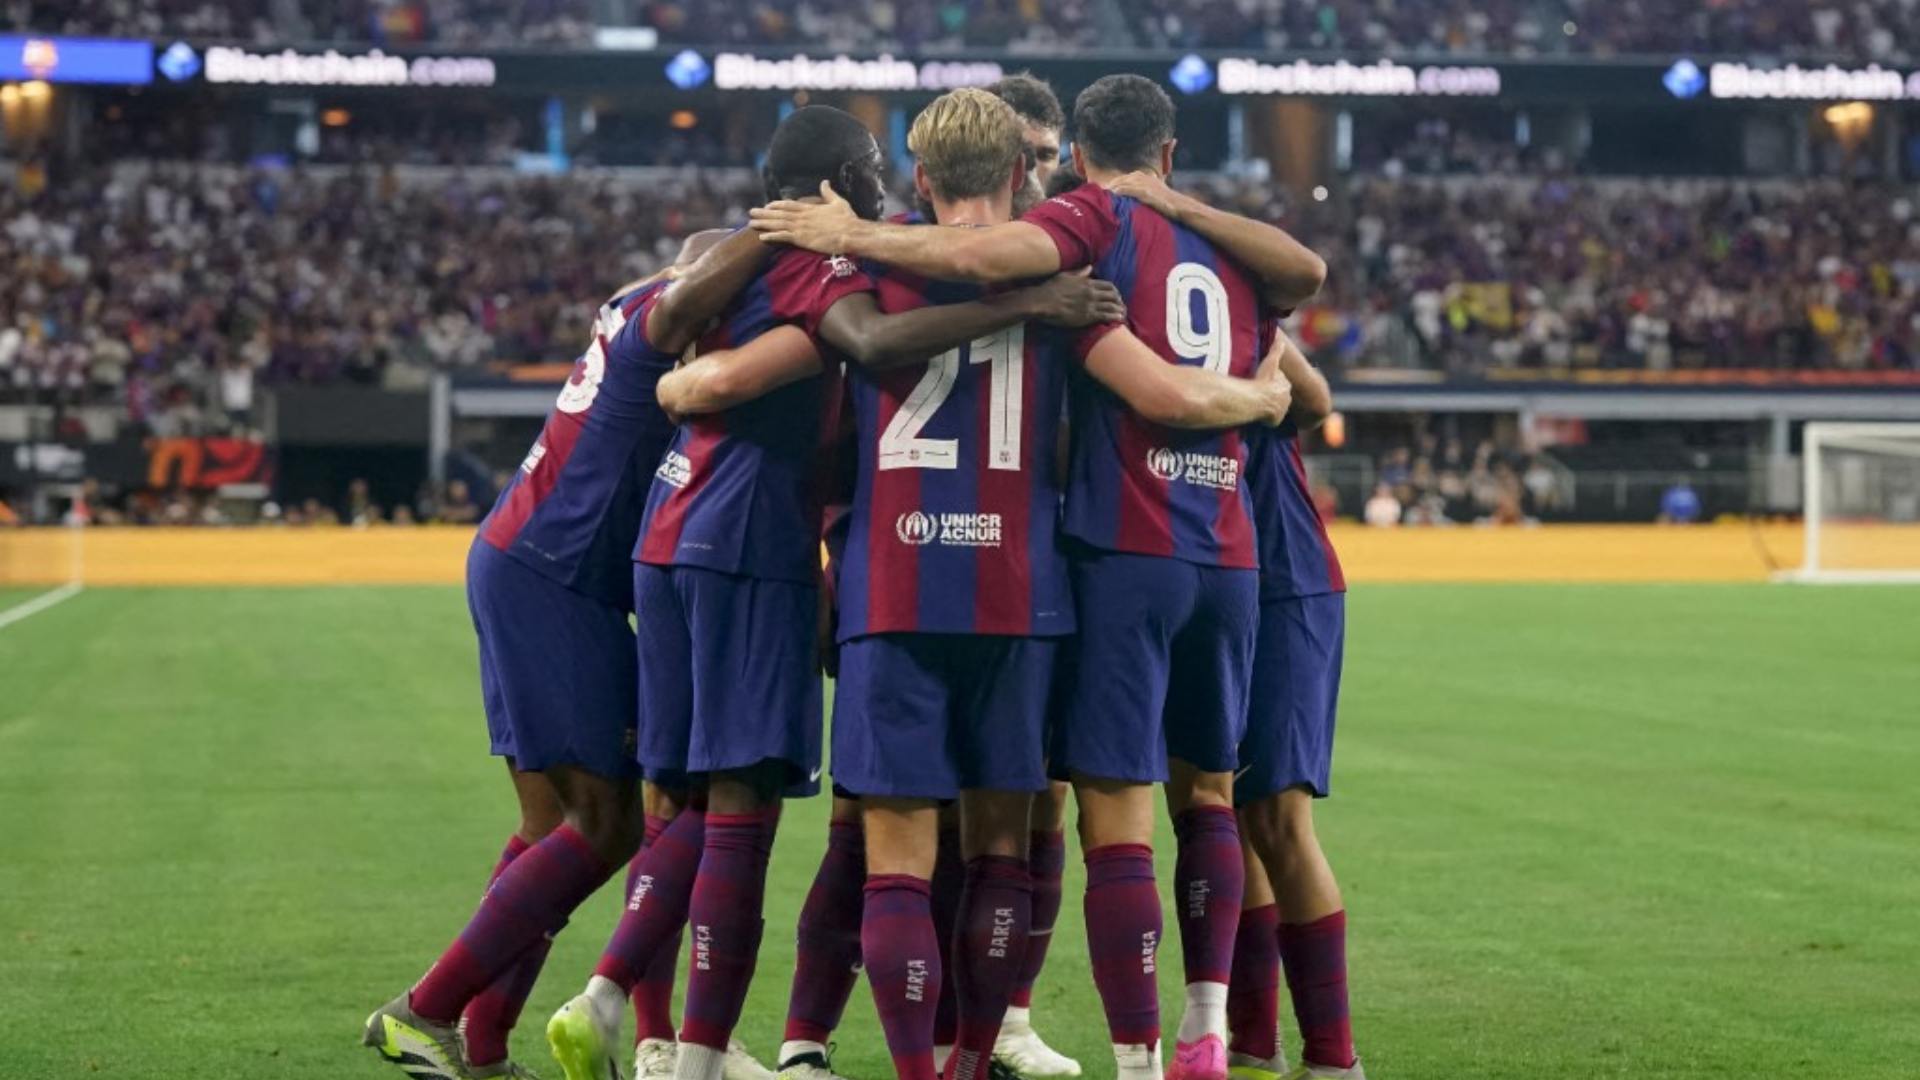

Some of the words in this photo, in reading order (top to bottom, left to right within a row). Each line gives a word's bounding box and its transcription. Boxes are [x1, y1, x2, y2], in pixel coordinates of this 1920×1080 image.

[204, 47, 495, 85] Blockchain.com
[714, 53, 1003, 89] Blockchain.com
[1217, 58, 1500, 95] Blockchain.com
[1166, 262, 1231, 377] 9
[879, 322, 1025, 471] 21
[1184, 466, 1238, 486] ACNUR
[1185, 453, 1239, 473] UNHCR
[940, 513, 1002, 528] UNHCR
[940, 528, 1002, 541] ACNUR
[627, 874, 655, 912] BARÇA
[696, 925, 713, 970] BARÇA
[988, 907, 1014, 958] BARÇA
[905, 960, 929, 1002] BARÇA
